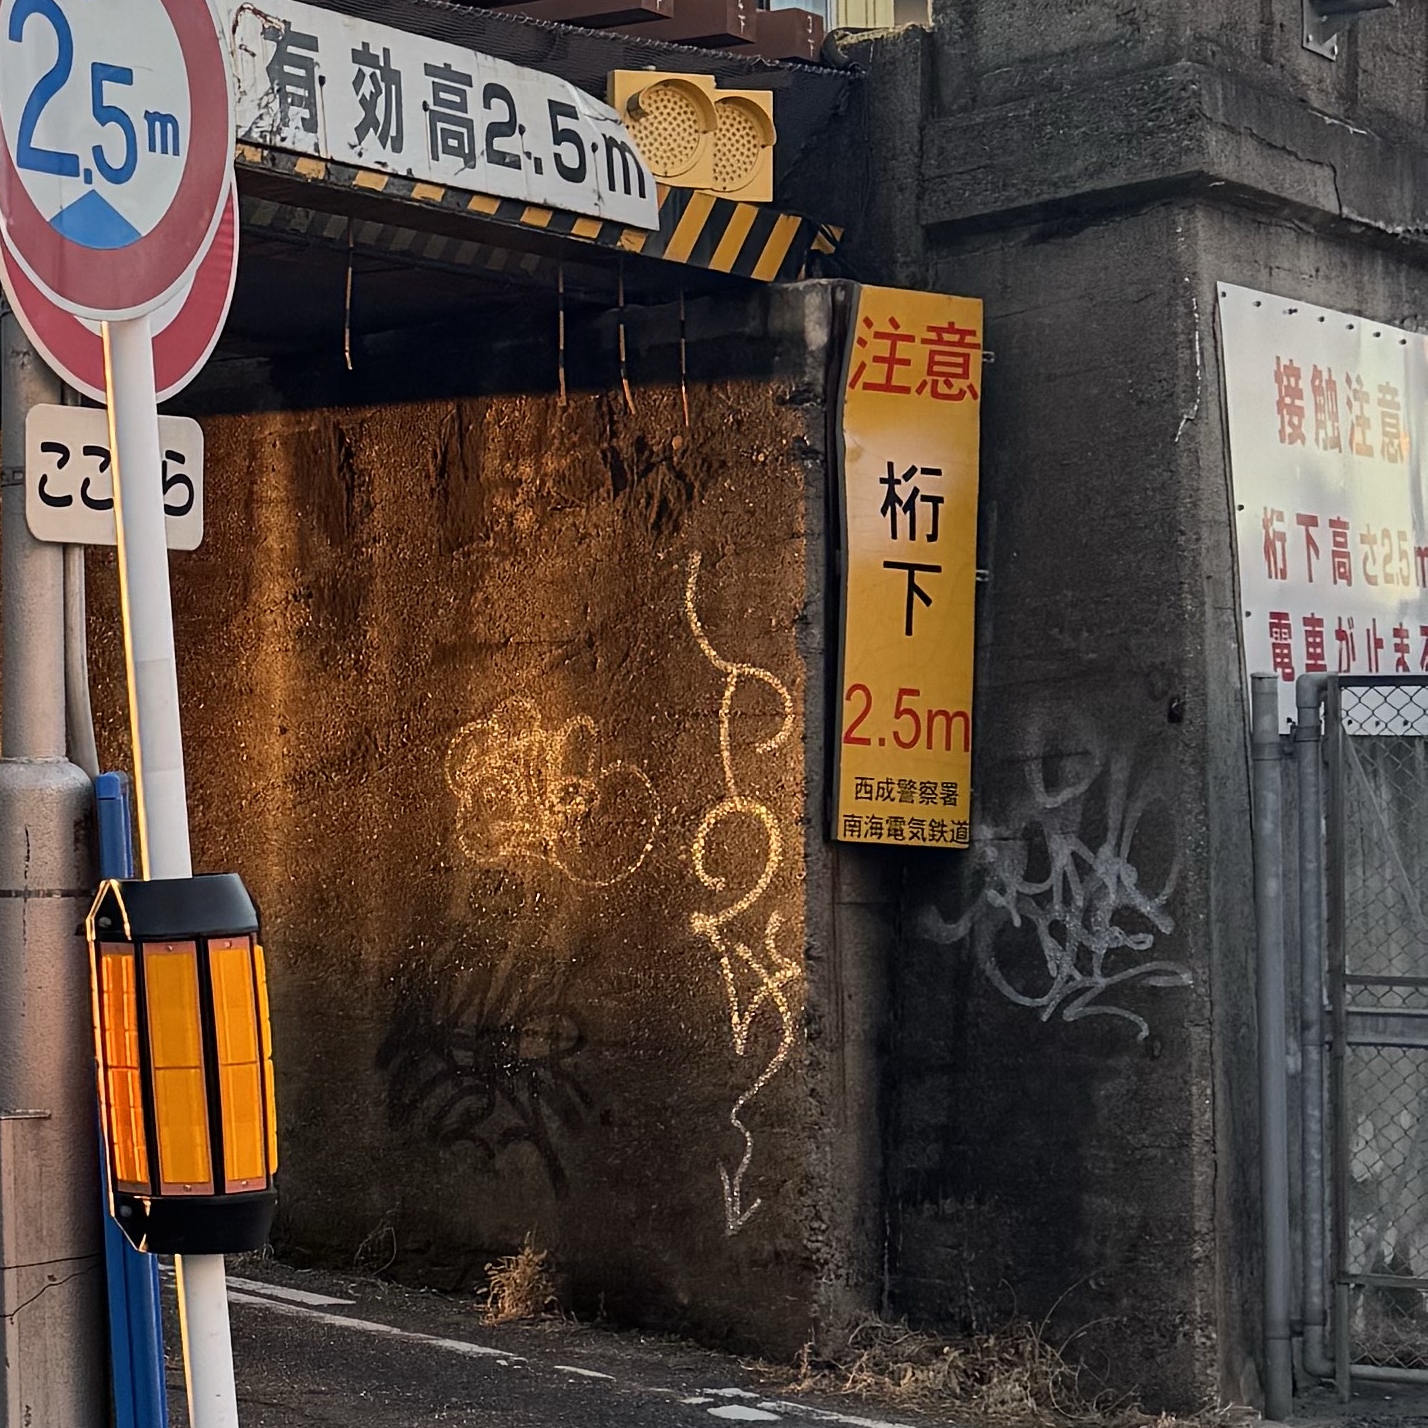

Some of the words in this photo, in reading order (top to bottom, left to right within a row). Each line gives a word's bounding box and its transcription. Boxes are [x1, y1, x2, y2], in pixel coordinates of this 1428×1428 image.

[847, 315, 982, 402] 注意
[1274, 355, 1404, 464] 接触注意
[38, 441, 195, 517] ここら
[879, 460, 945, 637] 桁下
[842, 683, 971, 753] 2.5m
[842, 813, 970, 845] 南海電気鉄道
[854, 776, 959, 807] 西成警察署
